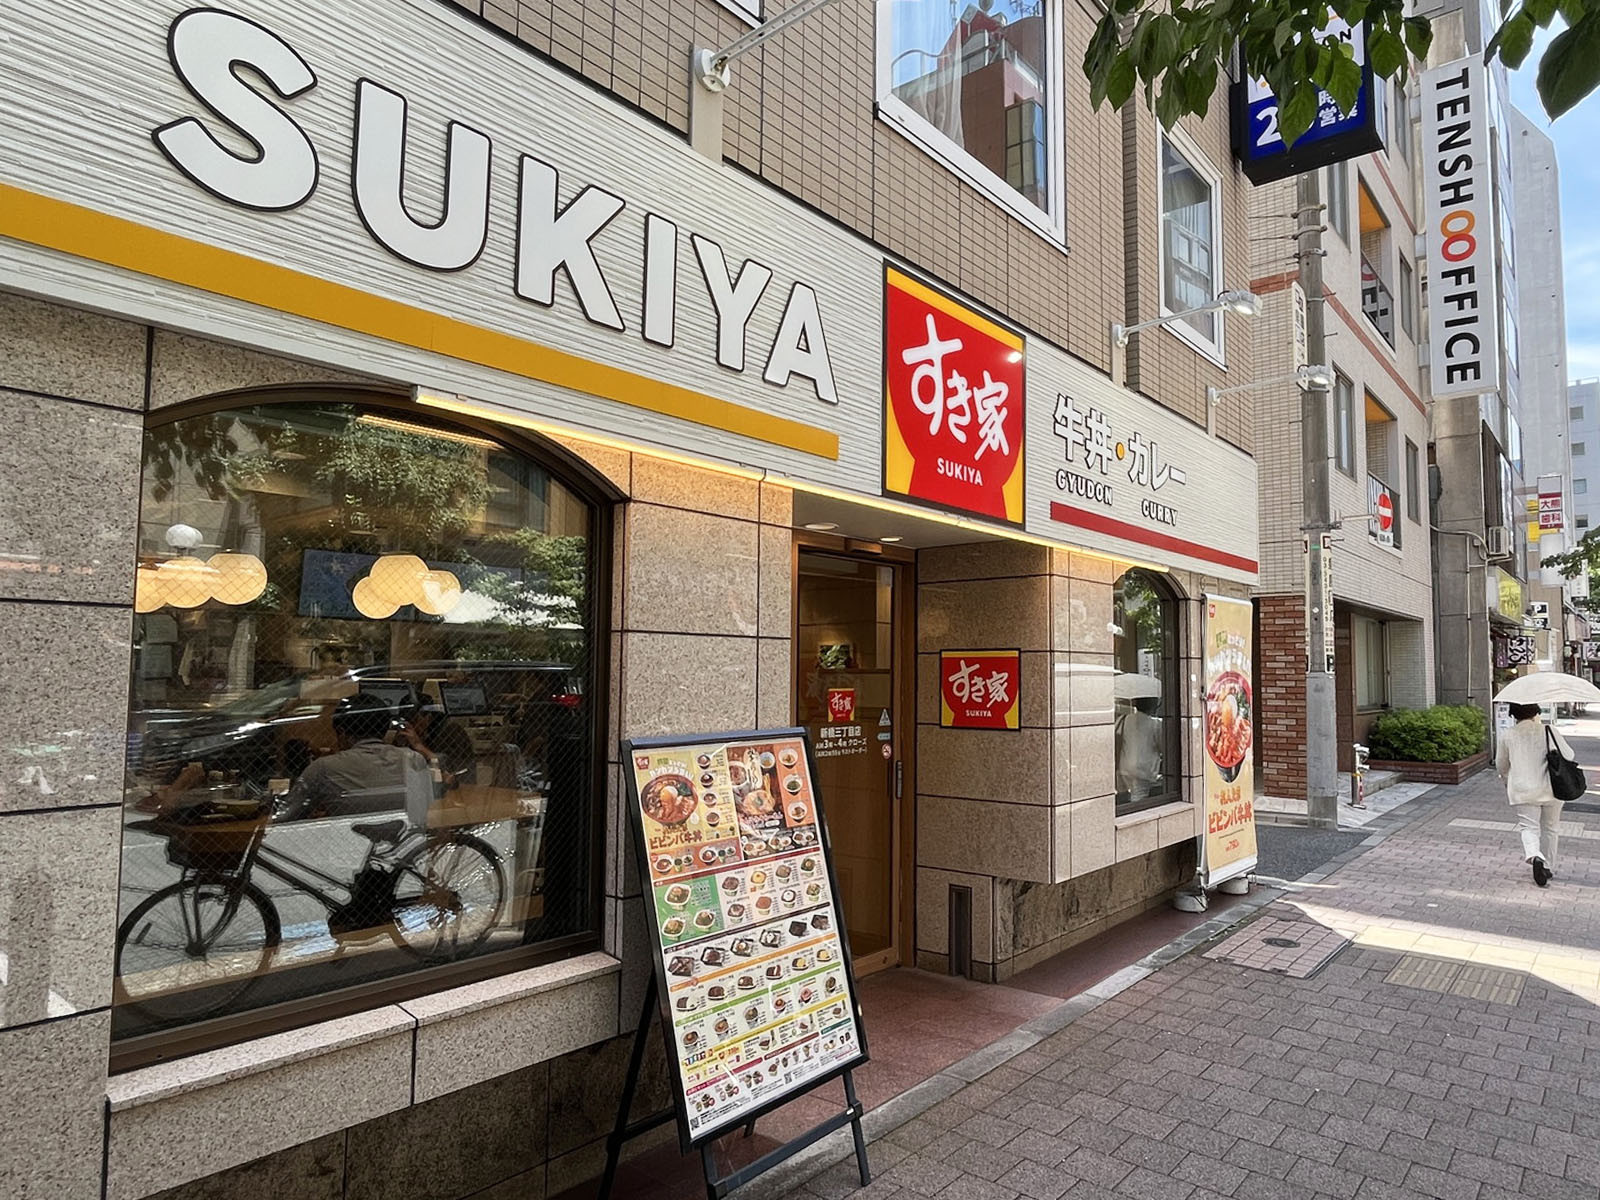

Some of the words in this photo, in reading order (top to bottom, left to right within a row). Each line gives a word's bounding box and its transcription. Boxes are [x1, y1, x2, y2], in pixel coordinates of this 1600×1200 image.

[151, 6, 839, 405] SUKIYA
[901, 313, 1010, 462] すき家
[936, 457, 984, 487] SUKIYA
[1055, 468, 1114, 507] GYUDON
[1140, 498, 1179, 528] CURRY
[948, 659, 1010, 708] すき家
[965, 709, 992, 718] SUKIYA
